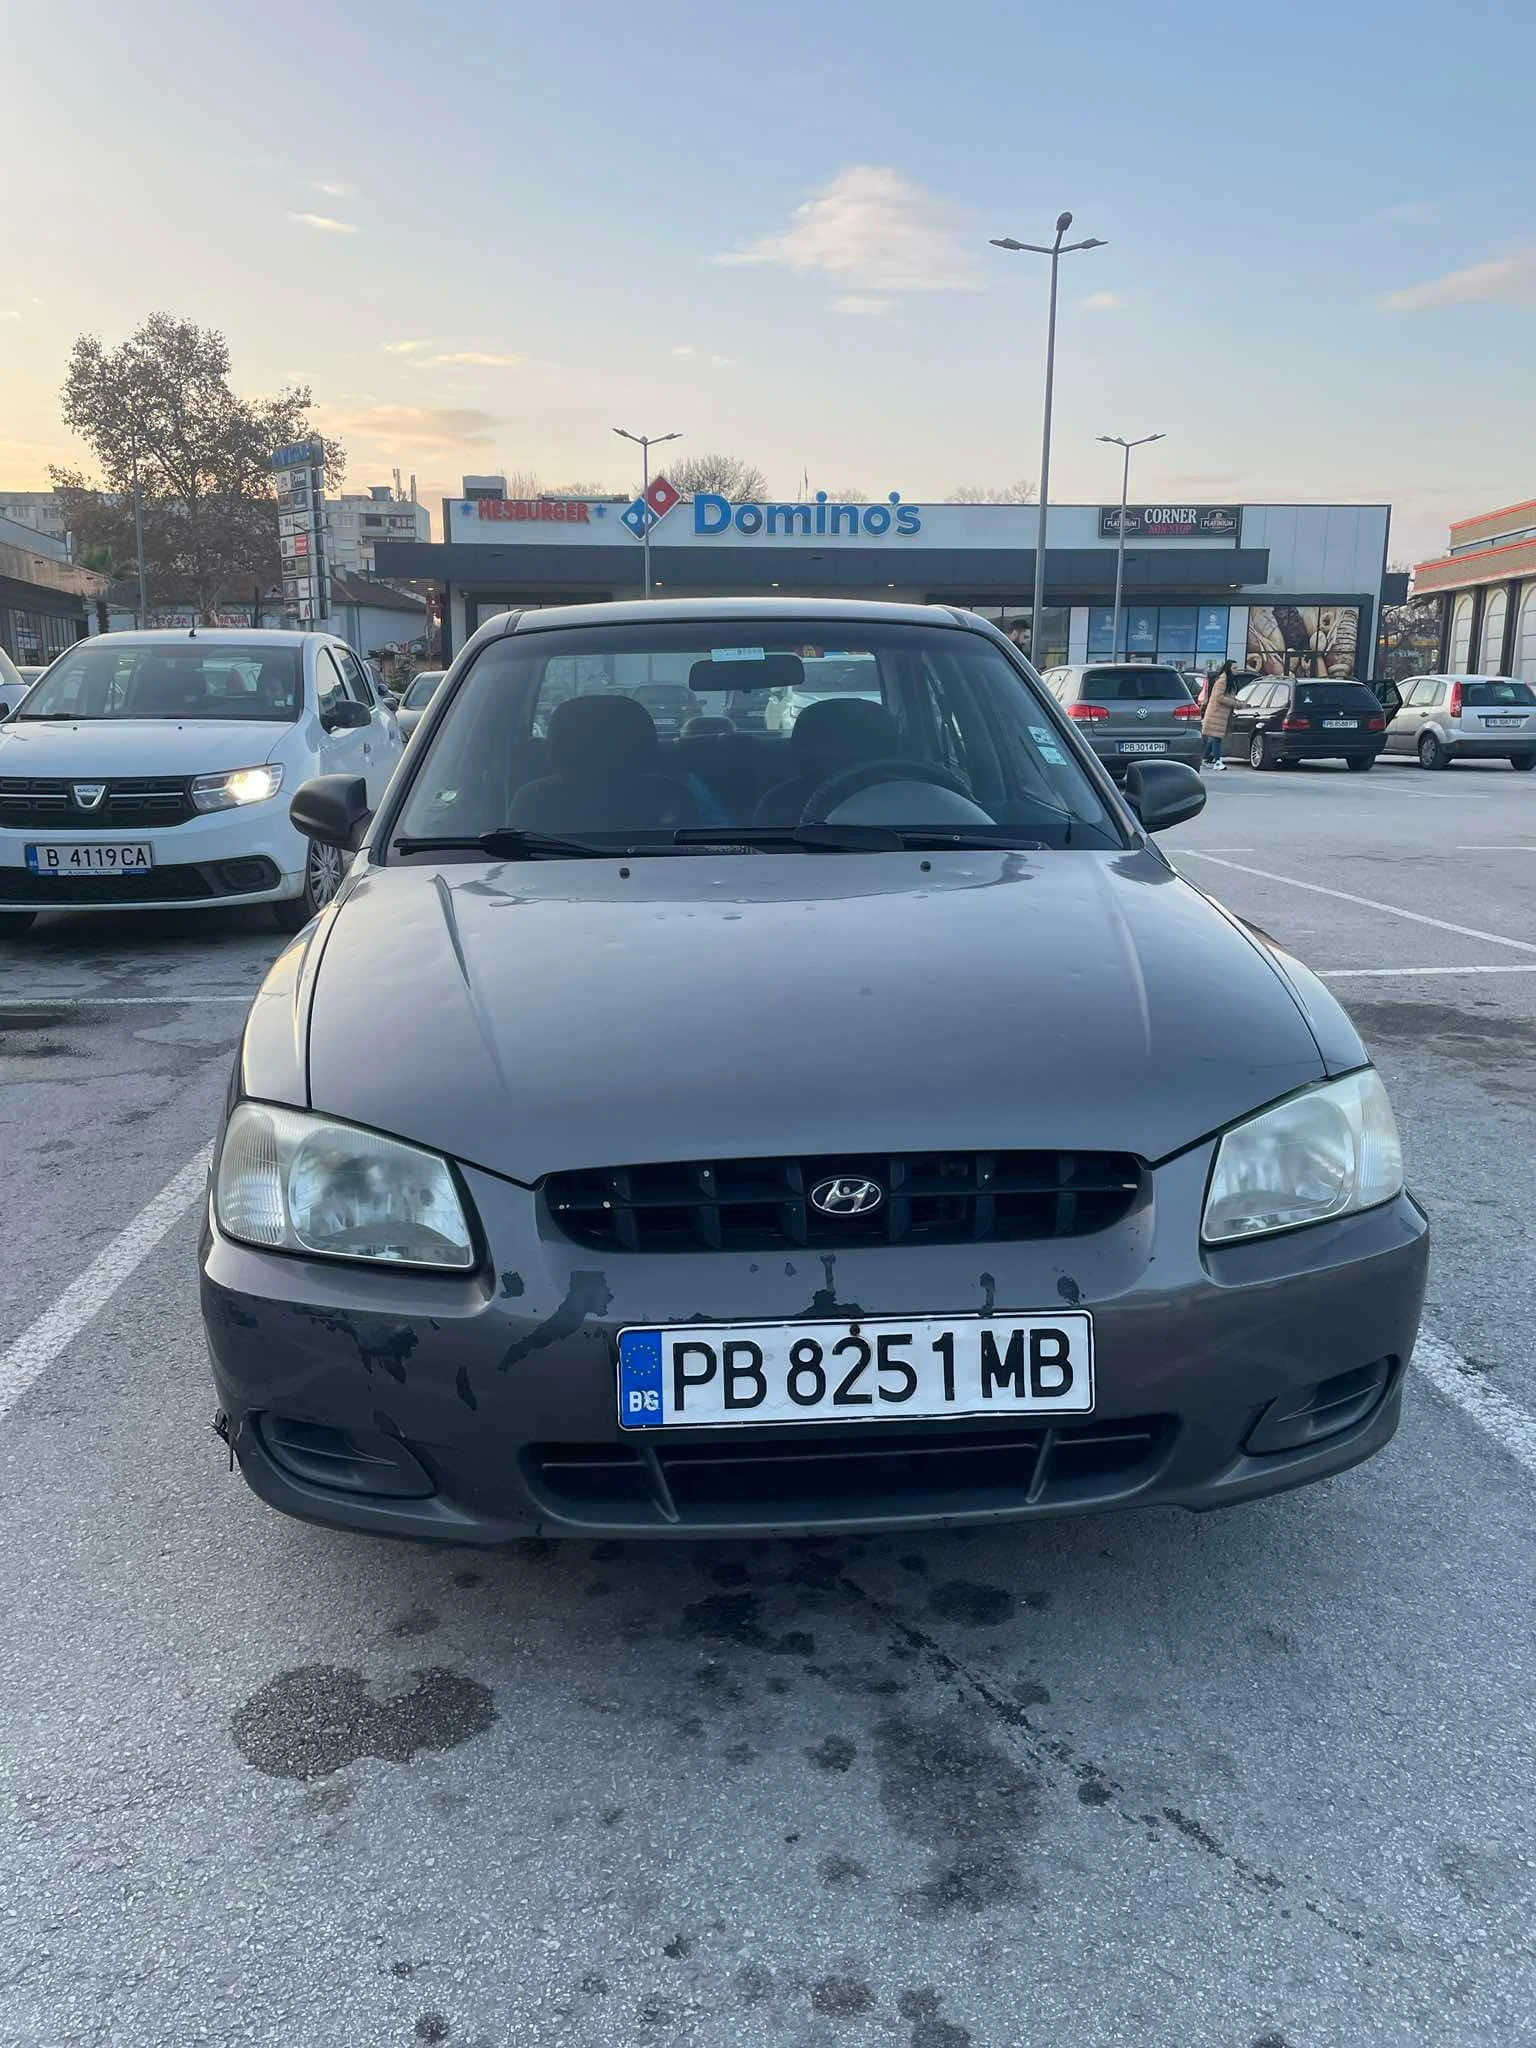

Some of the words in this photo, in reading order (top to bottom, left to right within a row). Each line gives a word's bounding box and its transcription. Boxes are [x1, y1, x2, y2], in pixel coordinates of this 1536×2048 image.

[694, 491, 921, 535] Domino's
[1144, 508, 1197, 524] CORNER
[46, 848, 60, 867] B
[673, 1340, 767, 1411] PB
[786, 1331, 955, 1407] 8251
[980, 1328, 1074, 1399] MB
[629, 1390, 659, 1412] BG
